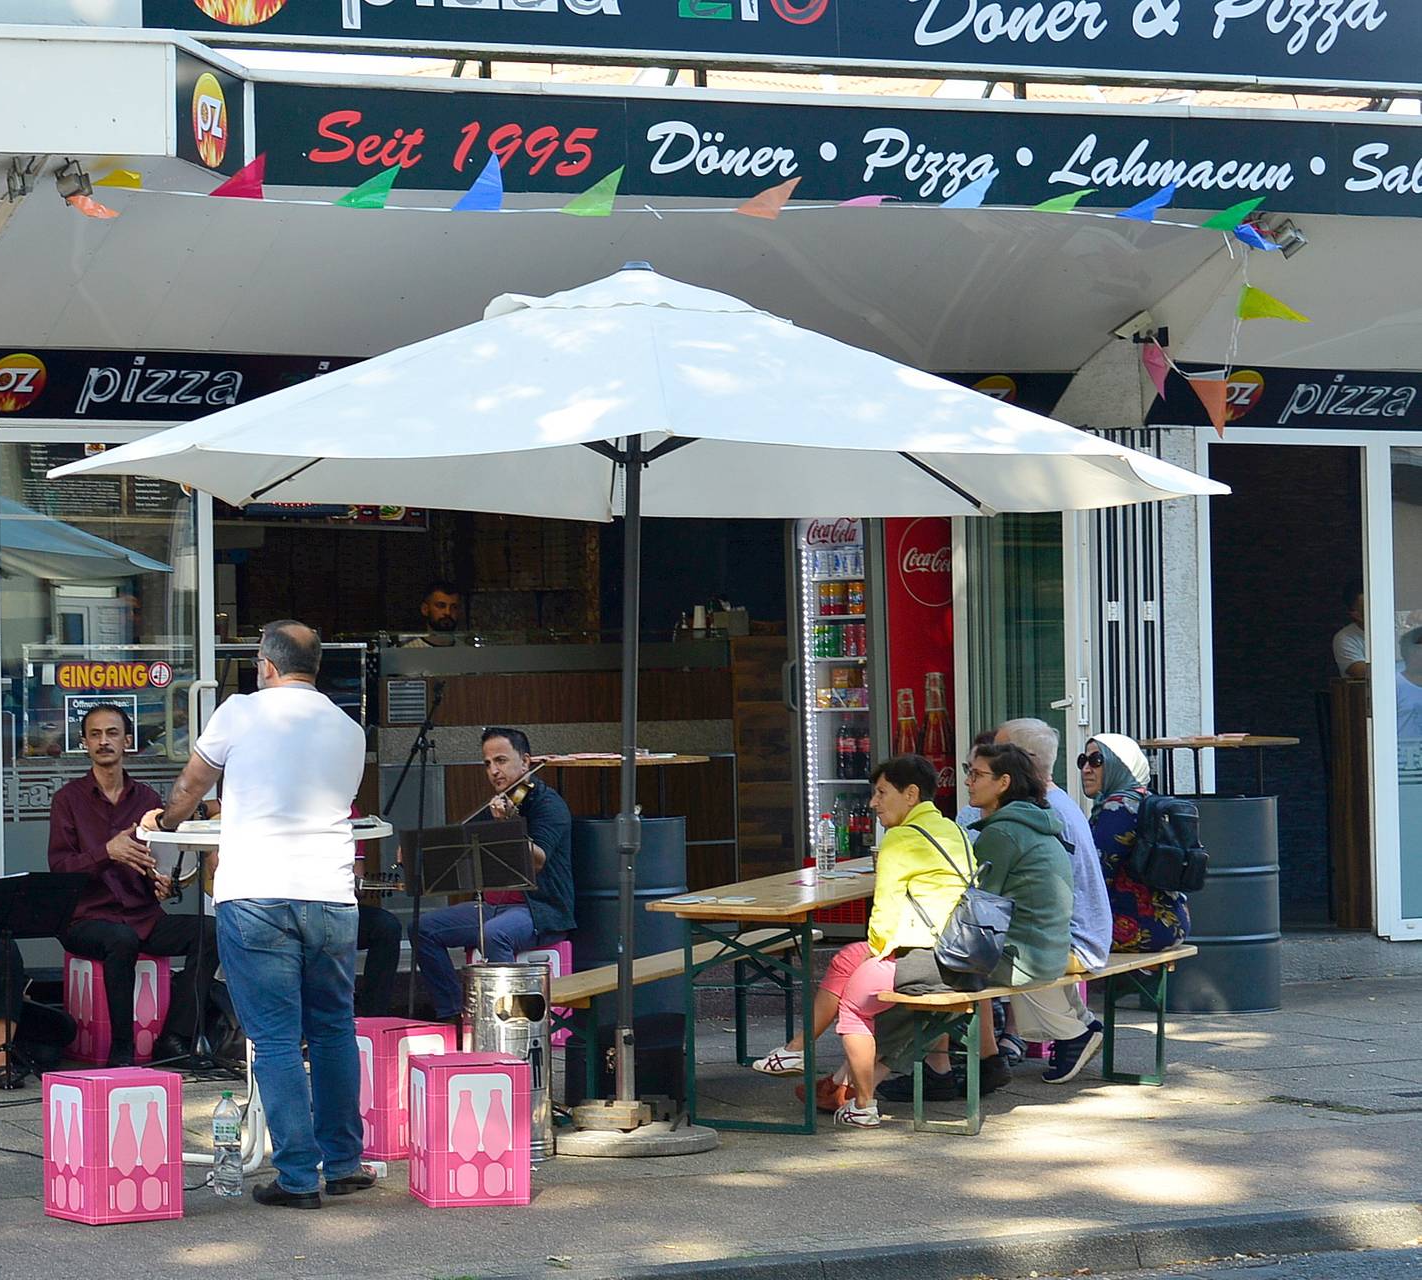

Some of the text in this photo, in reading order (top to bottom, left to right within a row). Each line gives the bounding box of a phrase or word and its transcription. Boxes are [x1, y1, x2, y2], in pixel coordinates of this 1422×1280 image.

[308, 110, 600, 178] Seit 1995
[646, 120, 799, 178] Döner
[861, 127, 996, 199] Pizza
[1048, 133, 1294, 192] Lahmacun
[74, 355, 244, 414] pizza
[1278, 374, 1418, 425] pizza
[58, 663, 148, 688] EINGANG
